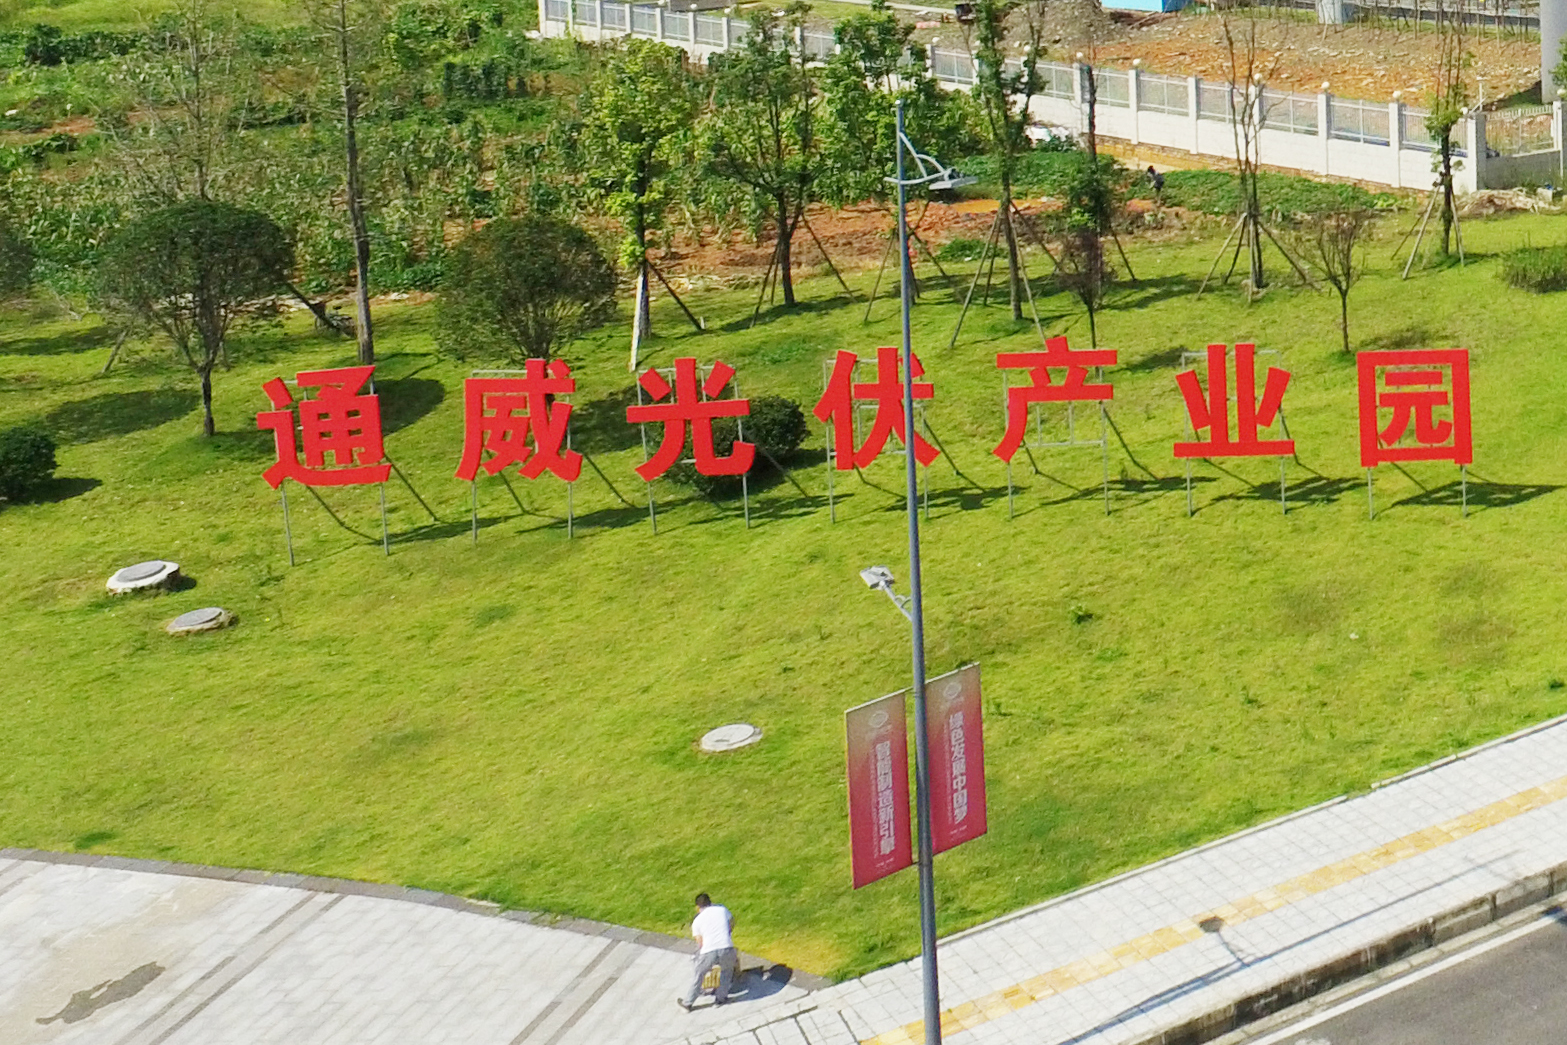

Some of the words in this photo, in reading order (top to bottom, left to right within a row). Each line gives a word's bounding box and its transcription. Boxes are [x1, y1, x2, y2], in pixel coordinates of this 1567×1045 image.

[256, 335, 1474, 490] 通威光伏产业园
